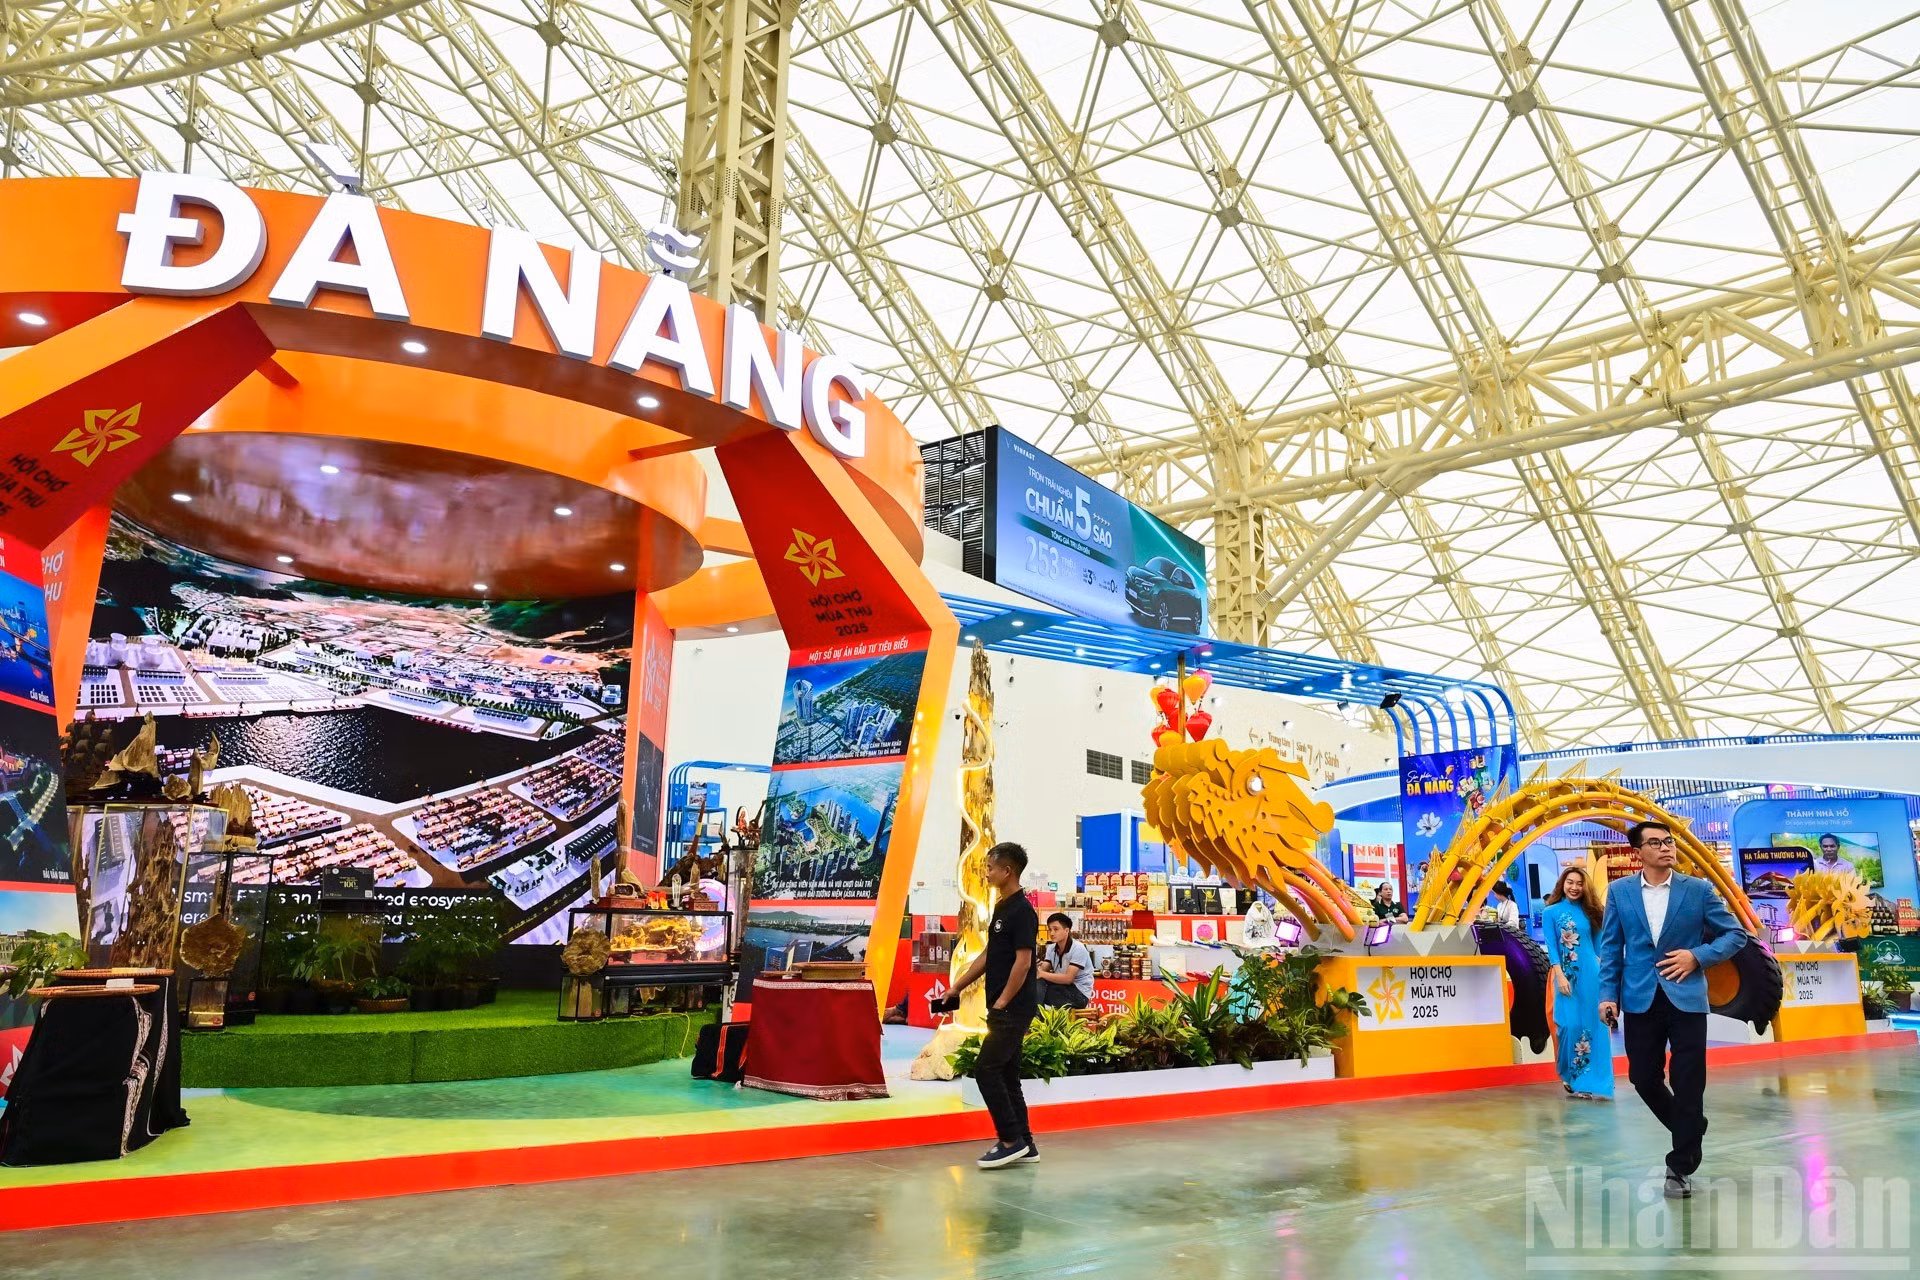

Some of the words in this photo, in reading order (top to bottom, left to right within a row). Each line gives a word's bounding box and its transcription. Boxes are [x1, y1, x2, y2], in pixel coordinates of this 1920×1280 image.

[116, 143, 411, 321] ĐÀ
[481, 222, 866, 458] NẴNG
[1075, 485, 1091, 541] 5
[1092, 524, 1112, 549] SAO
[1025, 536, 1059, 581] 253
[44, 581, 63, 602] HU
[1785, 808, 1814, 818] THÀNH
[1816, 808, 1834, 818] NHÀ
[1430, 965, 1452, 982] CHỢ
[1811, 975, 1822, 985] THU
[1411, 983, 1435, 999] MÙA
[1435, 985, 1456, 998] THU
[1799, 990, 1814, 1000] 2025
[1106, 1003, 1130, 1014] THU
[1412, 1005, 1439, 1019] 2025
